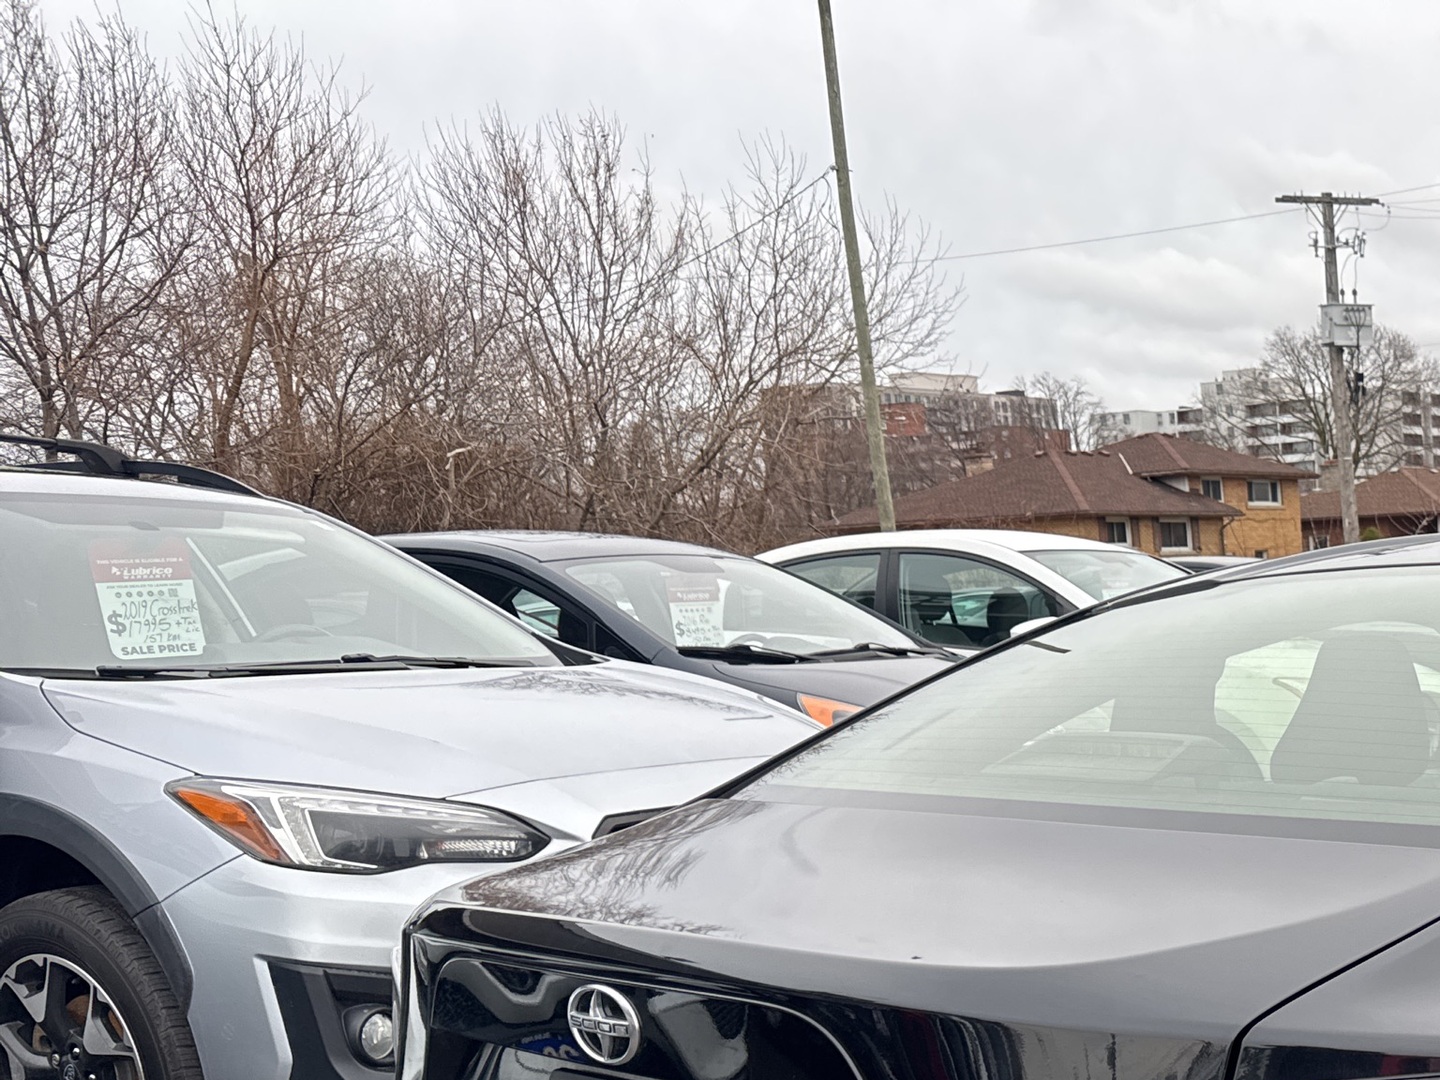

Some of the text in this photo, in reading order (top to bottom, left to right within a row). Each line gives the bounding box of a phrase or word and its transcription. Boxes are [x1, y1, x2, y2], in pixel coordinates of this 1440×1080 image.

[123, 566, 173, 576] Lubrico
[121, 598, 198, 620] 2019 Crosstrek
[121, 643, 197, 656] SALE PRICE
[570, 1015, 629, 1036] SCION
